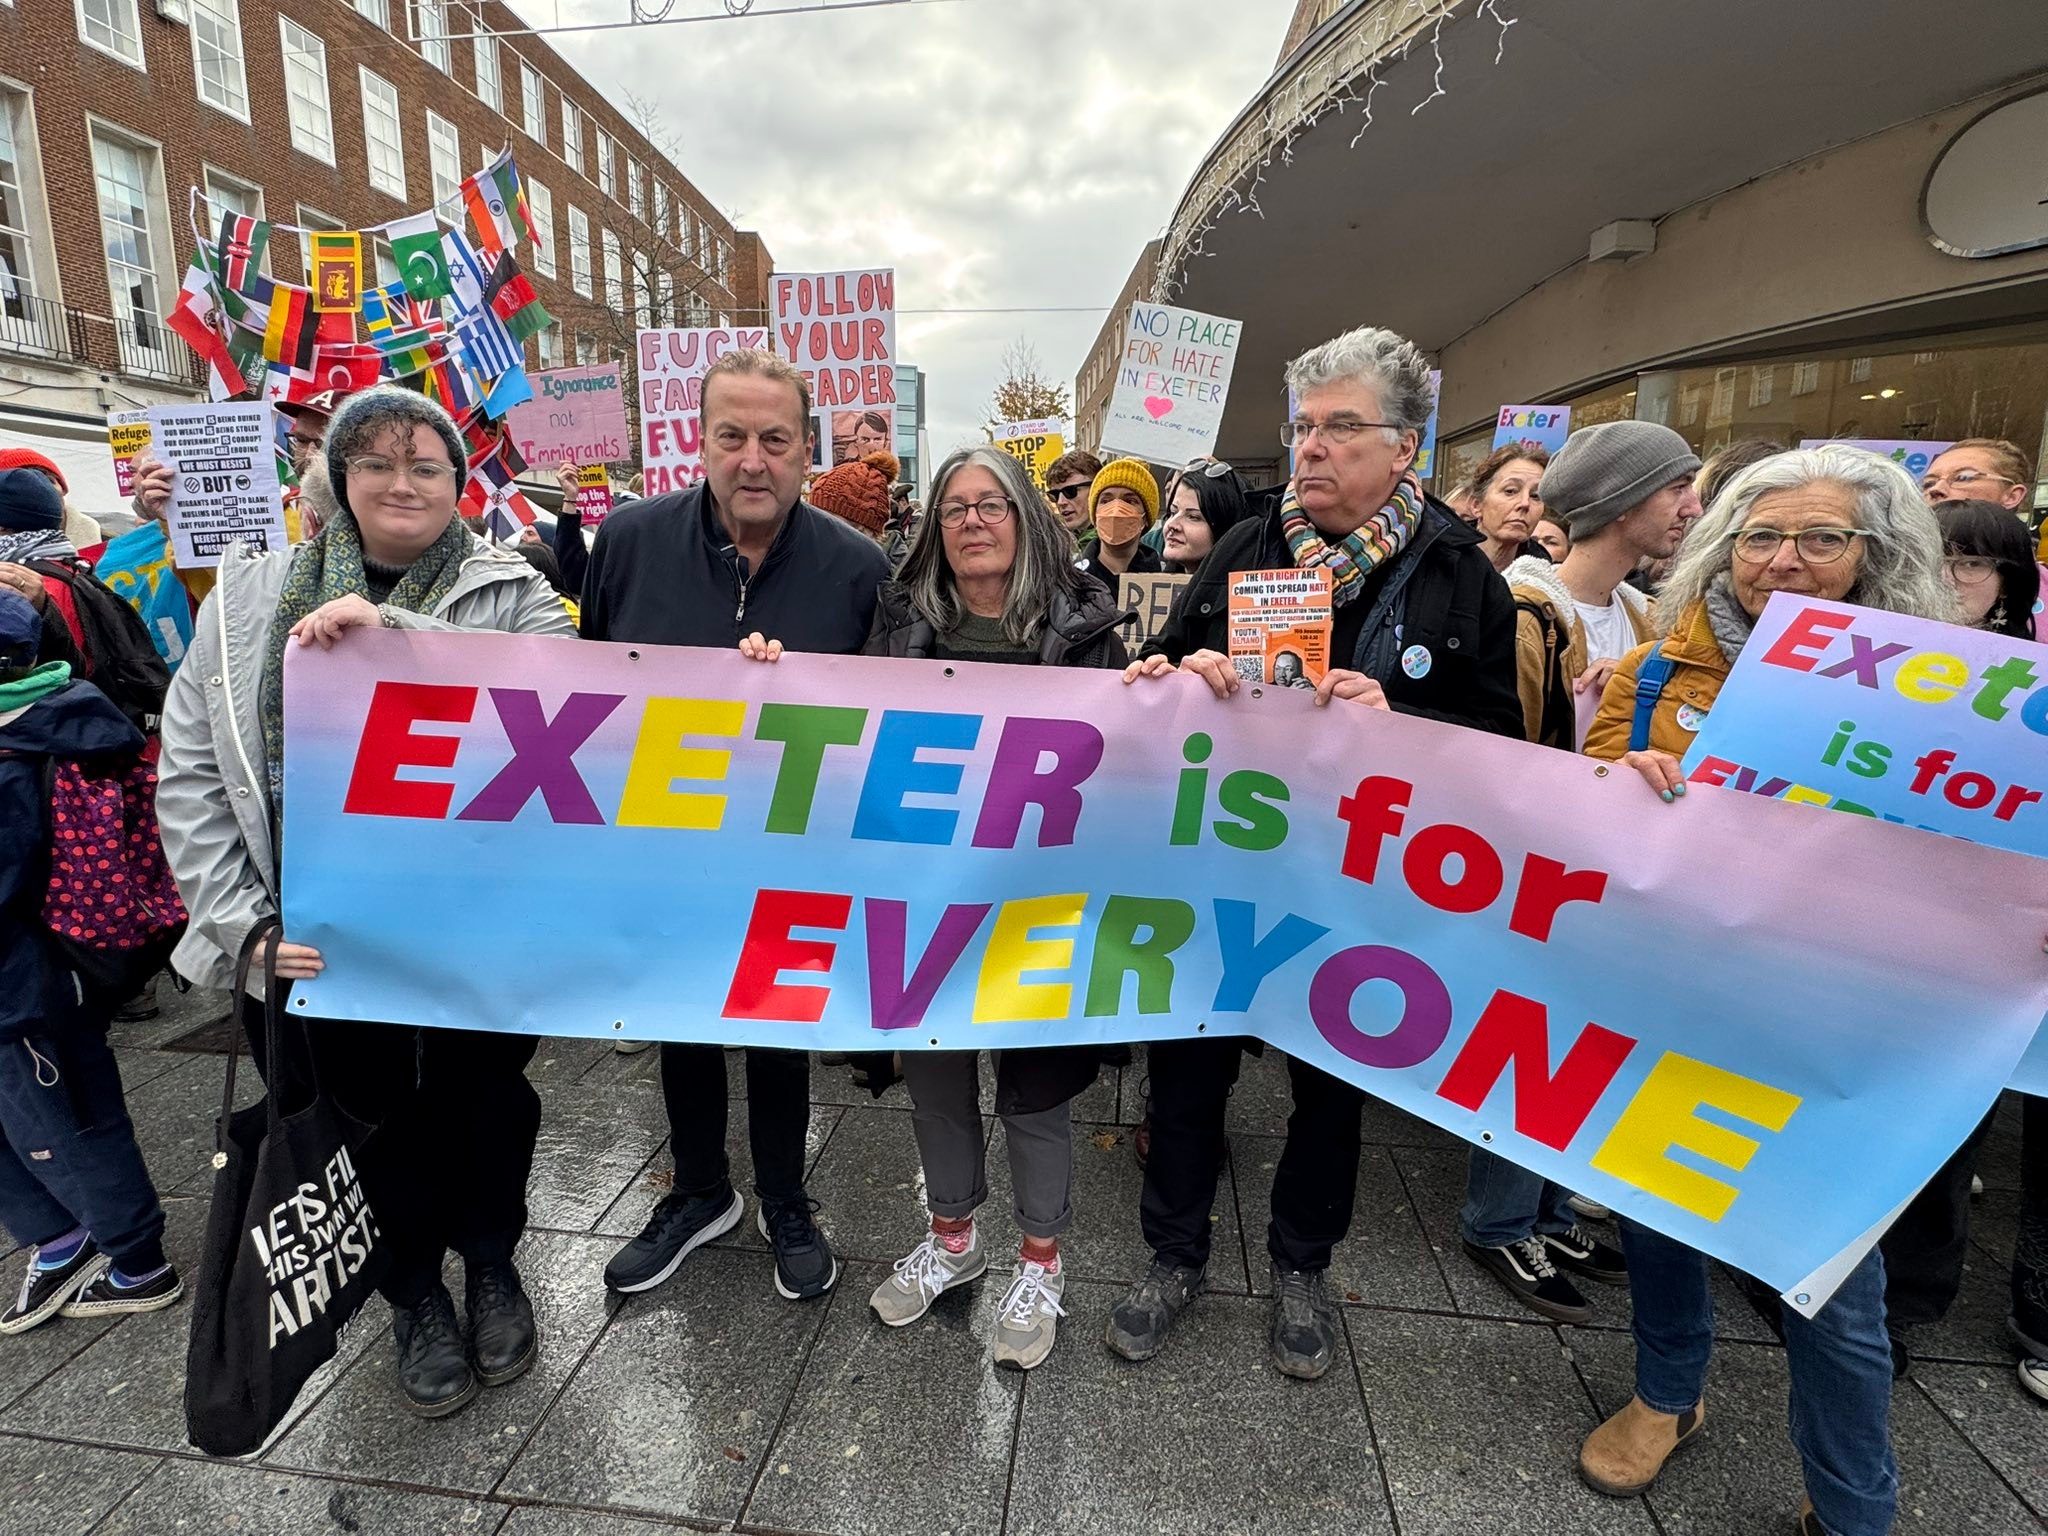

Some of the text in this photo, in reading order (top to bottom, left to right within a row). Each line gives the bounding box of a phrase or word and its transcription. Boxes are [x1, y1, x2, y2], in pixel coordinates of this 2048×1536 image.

[777, 271, 894, 318] FOLLOW
[1134, 308, 1237, 348] NO PLACE
[780, 317, 889, 363] YOUR
[1127, 339, 1224, 378] FOR HATE
[540, 373, 618, 401] Ignorance
[801, 364, 896, 408] EADER
[1120, 367, 1221, 404] IN EXETER
[306, 389, 335, 410] A
[160, 414, 261, 426] OUR COUNTRY IS BEING RUINED
[549, 410, 576, 428] not
[1131, 415, 1145, 423] ARE
[1500, 408, 1560, 428] Exeter
[164, 424, 260, 437] OUR WEALTH IS BEING STOLEN
[646, 417, 701, 458] FU
[114, 442, 146, 454] welco
[163, 435, 262, 447] OUR GOVERNMENT IS CORRUPT
[1004, 436, 1046, 454] STOP
[183, 448, 214, 456] LIBERTIES
[215, 446, 229, 455] ARE
[521, 435, 620, 464] Immigrants
[180, 458, 249, 471] WE MUST RESIST
[1016, 453, 1036, 468] HE
[202, 475, 232, 493] BUT
[176, 499, 210, 507] MIGRANTS
[210, 498, 223, 506] ARE
[223, 496, 237, 506] NOT
[247, 496, 270, 504] BLAME
[588, 488, 606, 500] the
[181, 510, 210, 518] MUSLIMS
[224, 508, 238, 517] NOT
[585, 502, 608, 517] right
[177, 521, 193, 529] LGBT
[193, 520, 216, 528] PEOPLE
[216, 519, 229, 527] ARE
[229, 518, 244, 527] NOT
[254, 517, 275, 525] BLAME
[193, 533, 221, 544] REJECT
[1245, 570, 1316, 582] THE FAR RIGHT ARE
[1234, 582, 1328, 595] COMING TO SPREAD HATE
[1260, 597, 1269, 606] IN
[1234, 628, 1257, 637] YOUTH
[1232, 636, 1260, 645] DEMAND
[1820, 720, 1893, 779] is
[1908, 748, 2044, 822] for
[342, 680, 1105, 849] EXETER
[1168, 732, 1292, 851] is
[1336, 773, 1609, 944] for
[721, 887, 1804, 1224] EVERYONE
